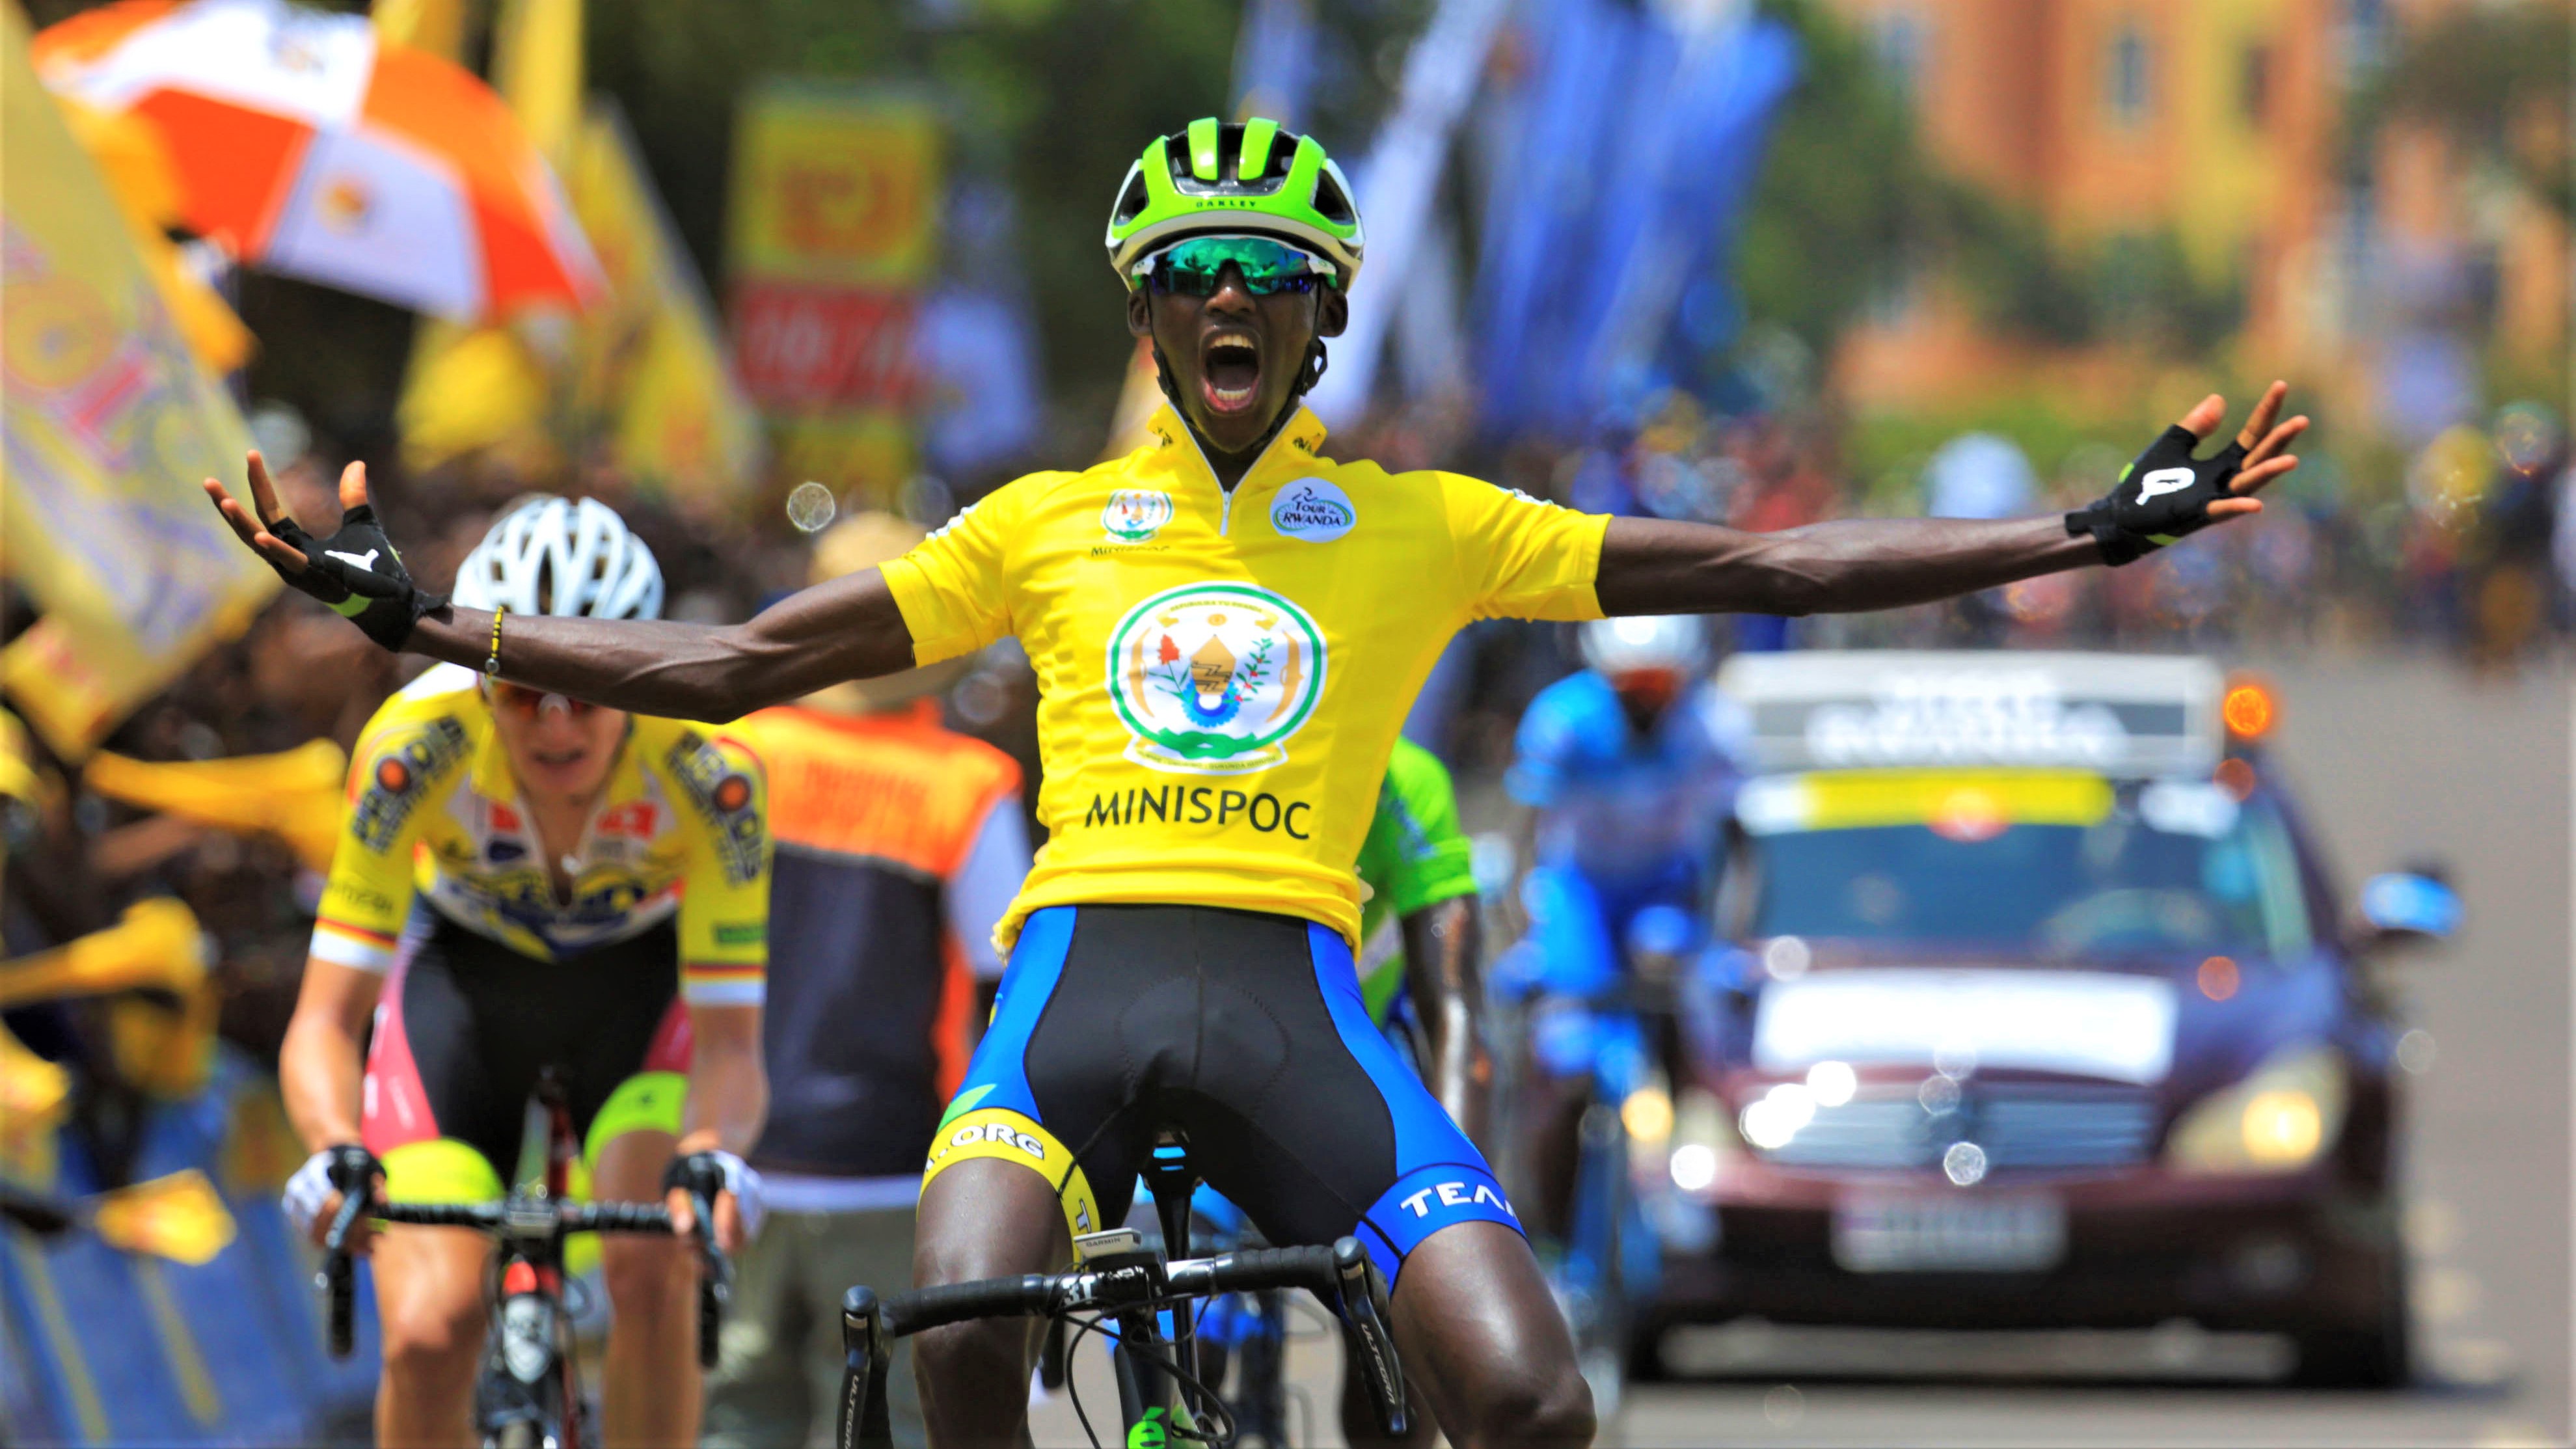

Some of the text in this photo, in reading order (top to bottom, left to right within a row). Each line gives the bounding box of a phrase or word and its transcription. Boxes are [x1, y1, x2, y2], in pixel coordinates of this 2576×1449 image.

[1295, 501, 1326, 513] TOUR
[1283, 512, 1341, 526] RWANDA
[1085, 785, 1311, 841] MINISPOC
[1086, 1237, 1121, 1247] GARMIN
[1361, 1322, 1396, 1405] ULTEGRA
